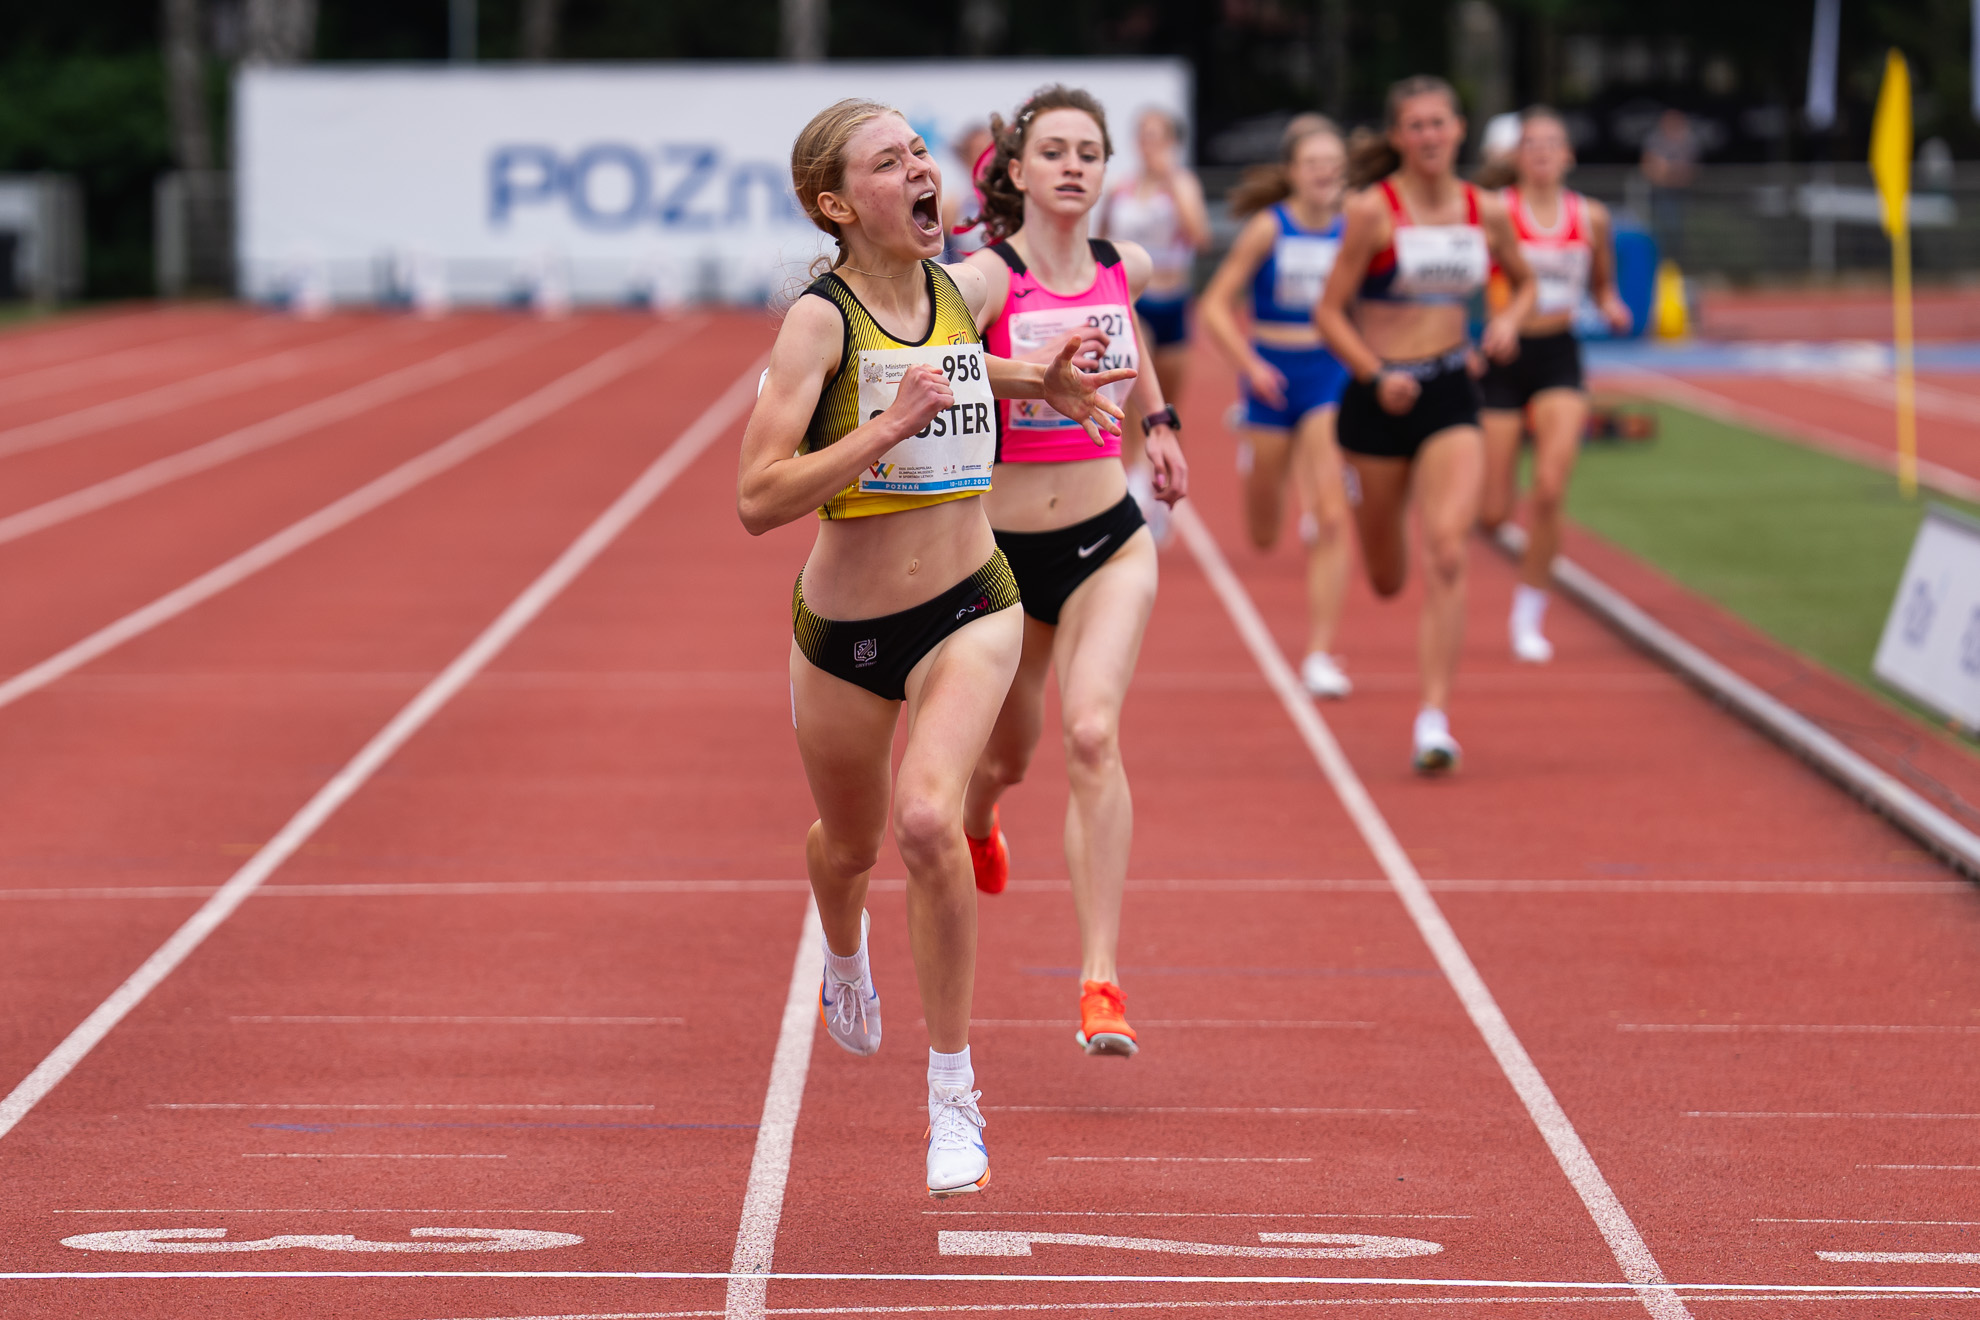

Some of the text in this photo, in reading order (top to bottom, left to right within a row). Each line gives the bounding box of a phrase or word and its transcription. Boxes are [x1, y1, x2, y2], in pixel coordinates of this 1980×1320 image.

[488, 142, 802, 233] POZn
[942, 353, 981, 383] 958
[60, 1226, 1444, 1260] 3 2
